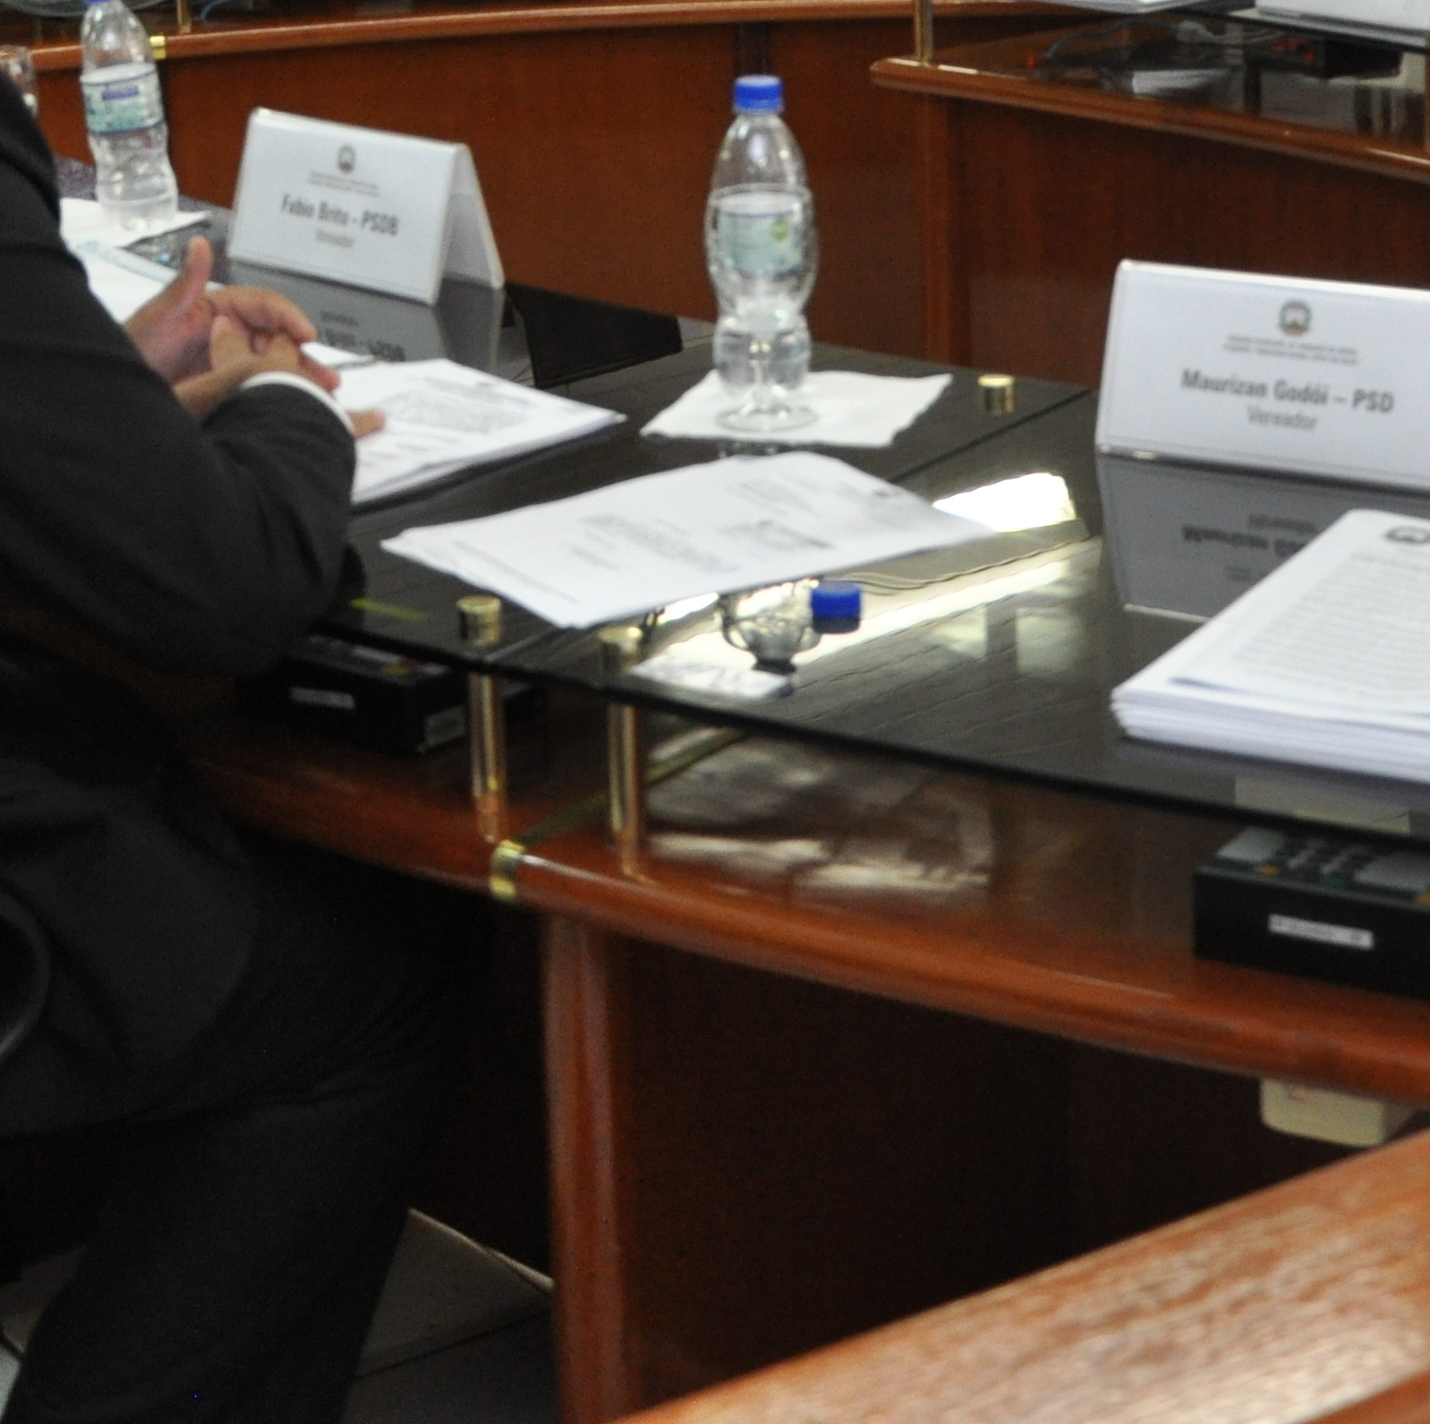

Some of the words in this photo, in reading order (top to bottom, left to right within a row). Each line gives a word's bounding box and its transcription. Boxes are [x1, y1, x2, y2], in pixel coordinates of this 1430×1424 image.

[1182, 369, 1267, 399] Maurizan
[1354, 390, 1394, 413] PSD
[1249, 405, 1318, 430] Vereador
